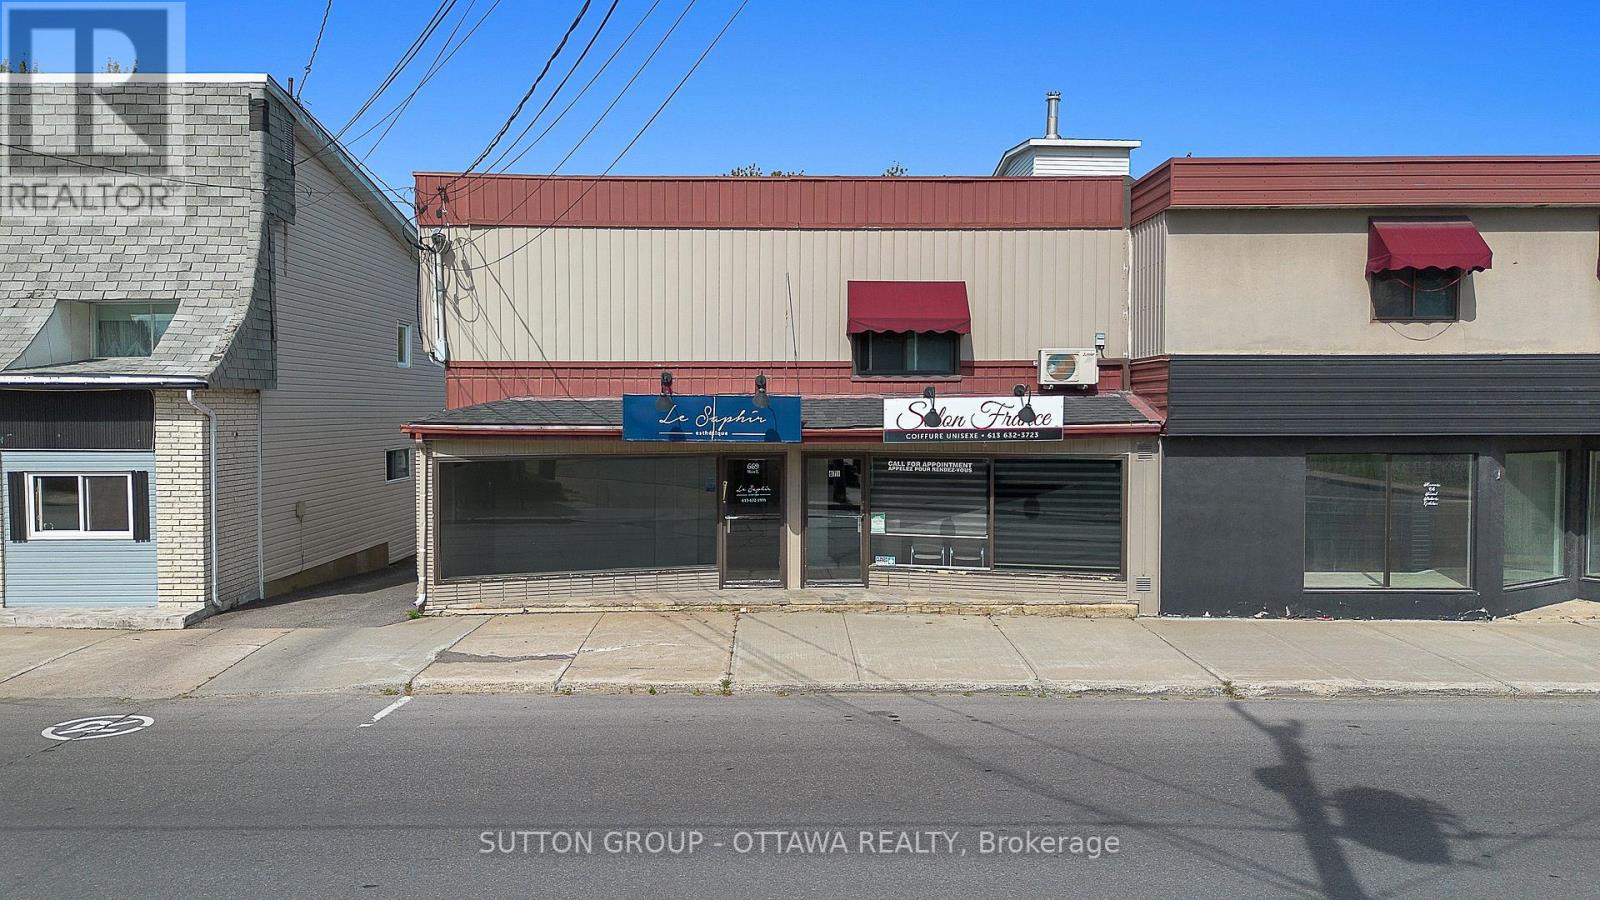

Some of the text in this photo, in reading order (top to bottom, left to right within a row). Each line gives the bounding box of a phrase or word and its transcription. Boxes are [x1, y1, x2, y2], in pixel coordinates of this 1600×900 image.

[658, 404, 767, 431] Le Saphir
[896, 400, 966, 430] Slon
